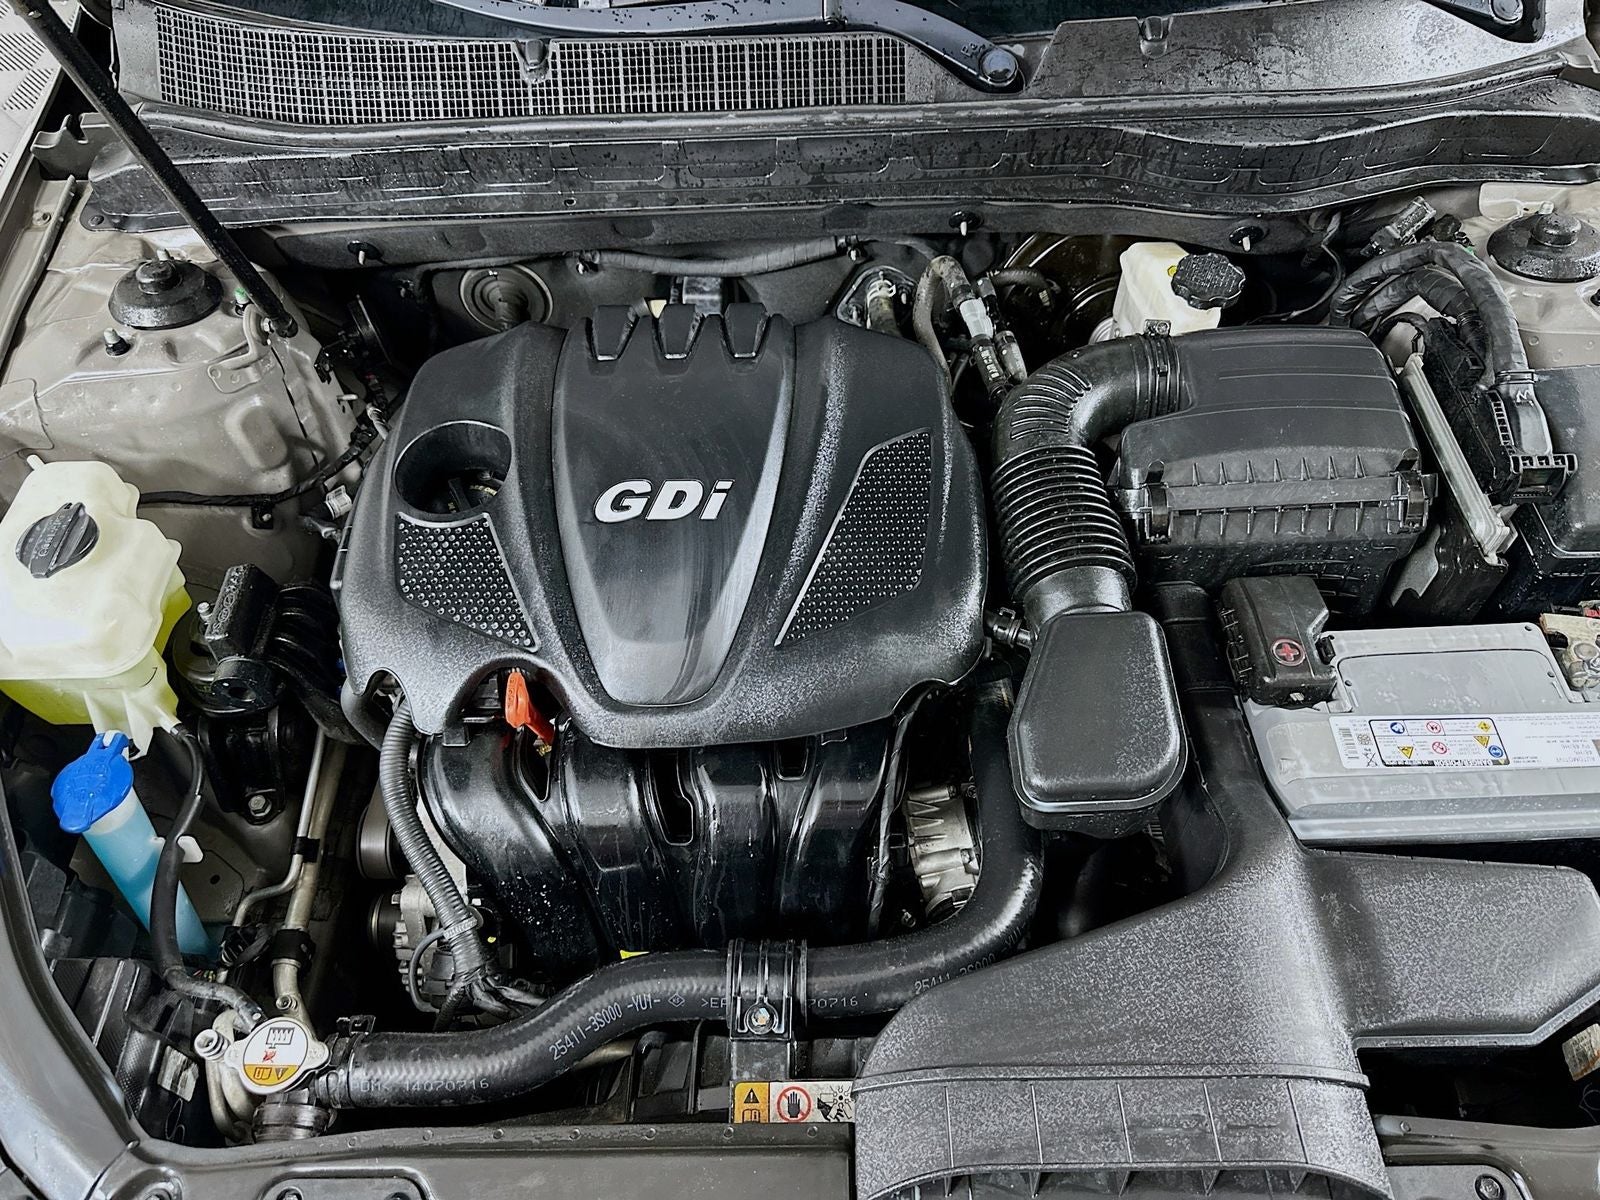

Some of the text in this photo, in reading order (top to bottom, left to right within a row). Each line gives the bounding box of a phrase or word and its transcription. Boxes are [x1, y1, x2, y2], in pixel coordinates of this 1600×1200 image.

[594, 479, 735, 523] GDi
[549, 1002, 623, 1061] 25411-3S000
[808, 996, 859, 1008] 70716
[405, 1078, 490, 1092] 14070716
